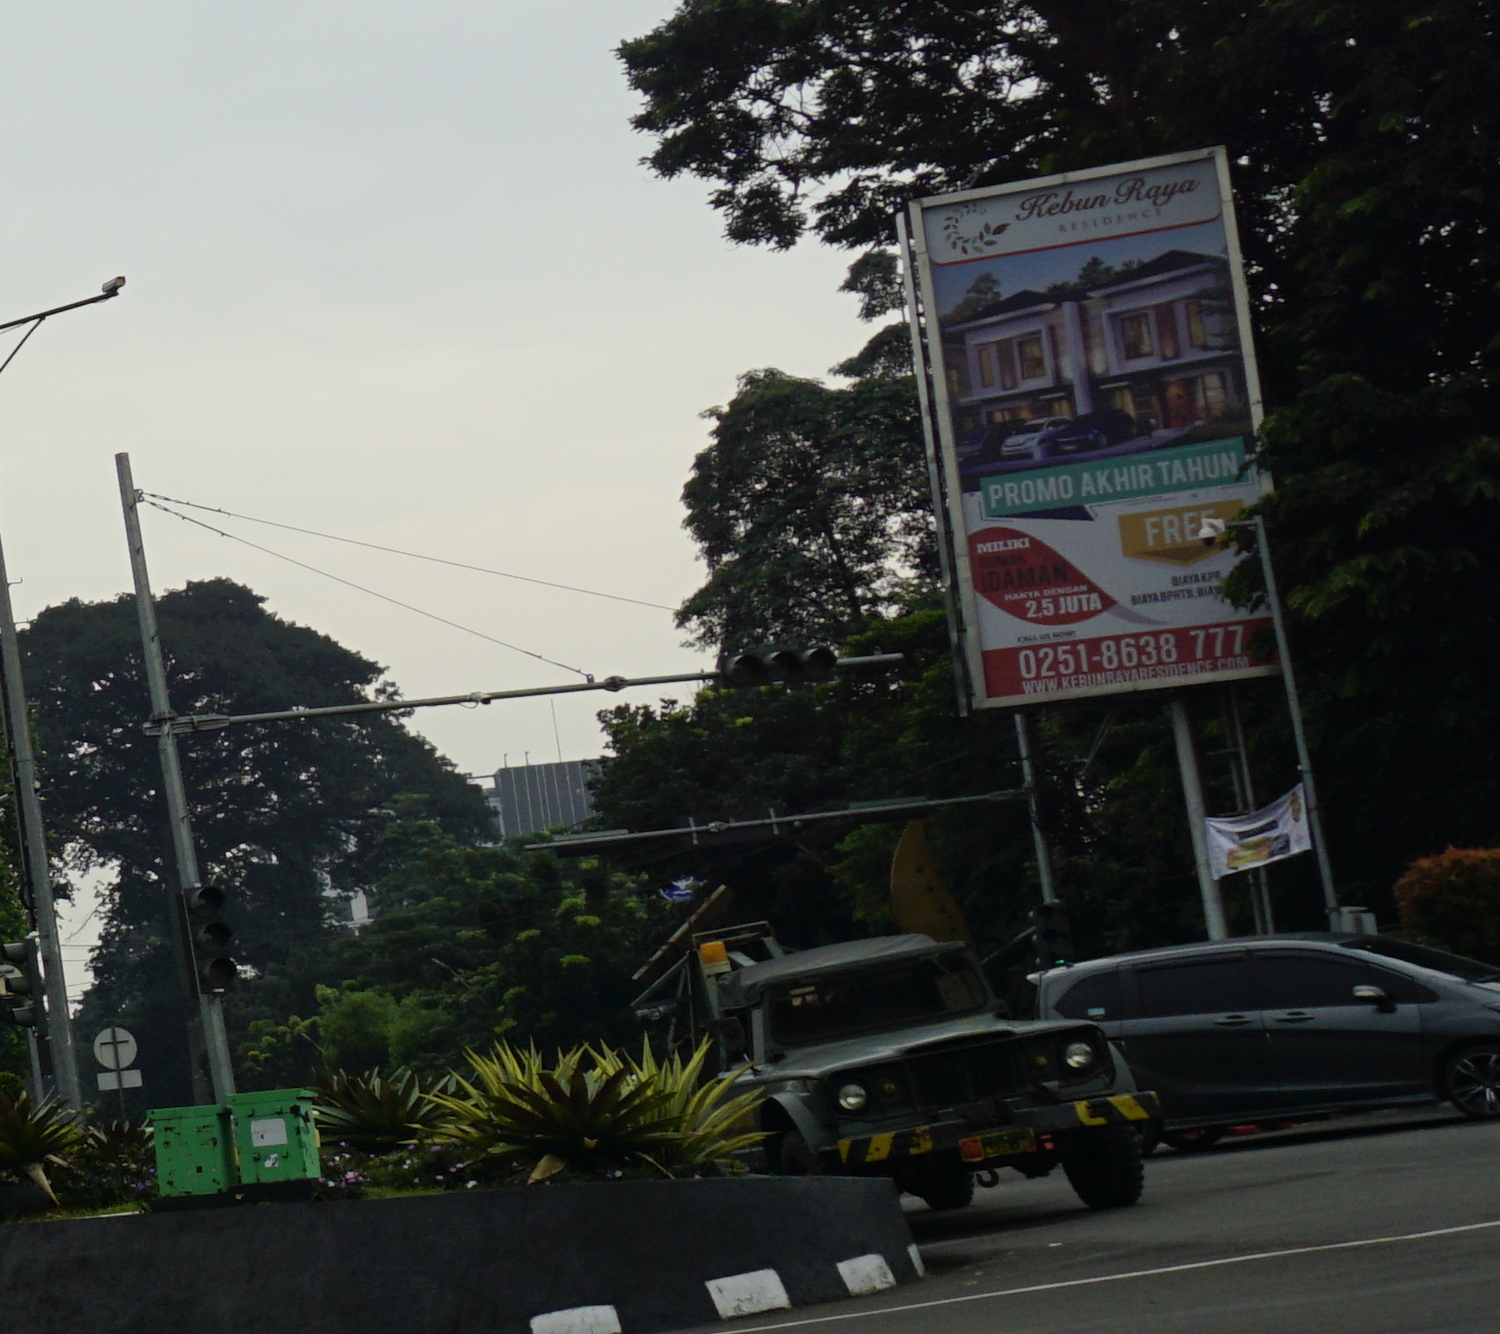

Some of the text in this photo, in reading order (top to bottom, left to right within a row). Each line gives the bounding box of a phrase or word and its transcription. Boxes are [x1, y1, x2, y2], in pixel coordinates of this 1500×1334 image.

[1015, 177, 1200, 221] Kebun Raya
[1059, 208, 1162, 233] RESIDENCE
[988, 451, 1239, 509] PROMO AKHIR TAHUN
[976, 537, 1031, 554] MILIKI
[982, 562, 1069, 593] IDAMAN
[1171, 573, 1200, 587] BIAYA
[1004, 584, 1088, 601] HANYA DENGAN
[1025, 592, 1103, 619] 2,5 JUTA
[1131, 592, 1160, 605] BIAYA
[1019, 625, 1245, 679] 0251-8638 777
[1023, 655, 1249, 695] WWW.KEBUNRAYARESIDENCE.COM
